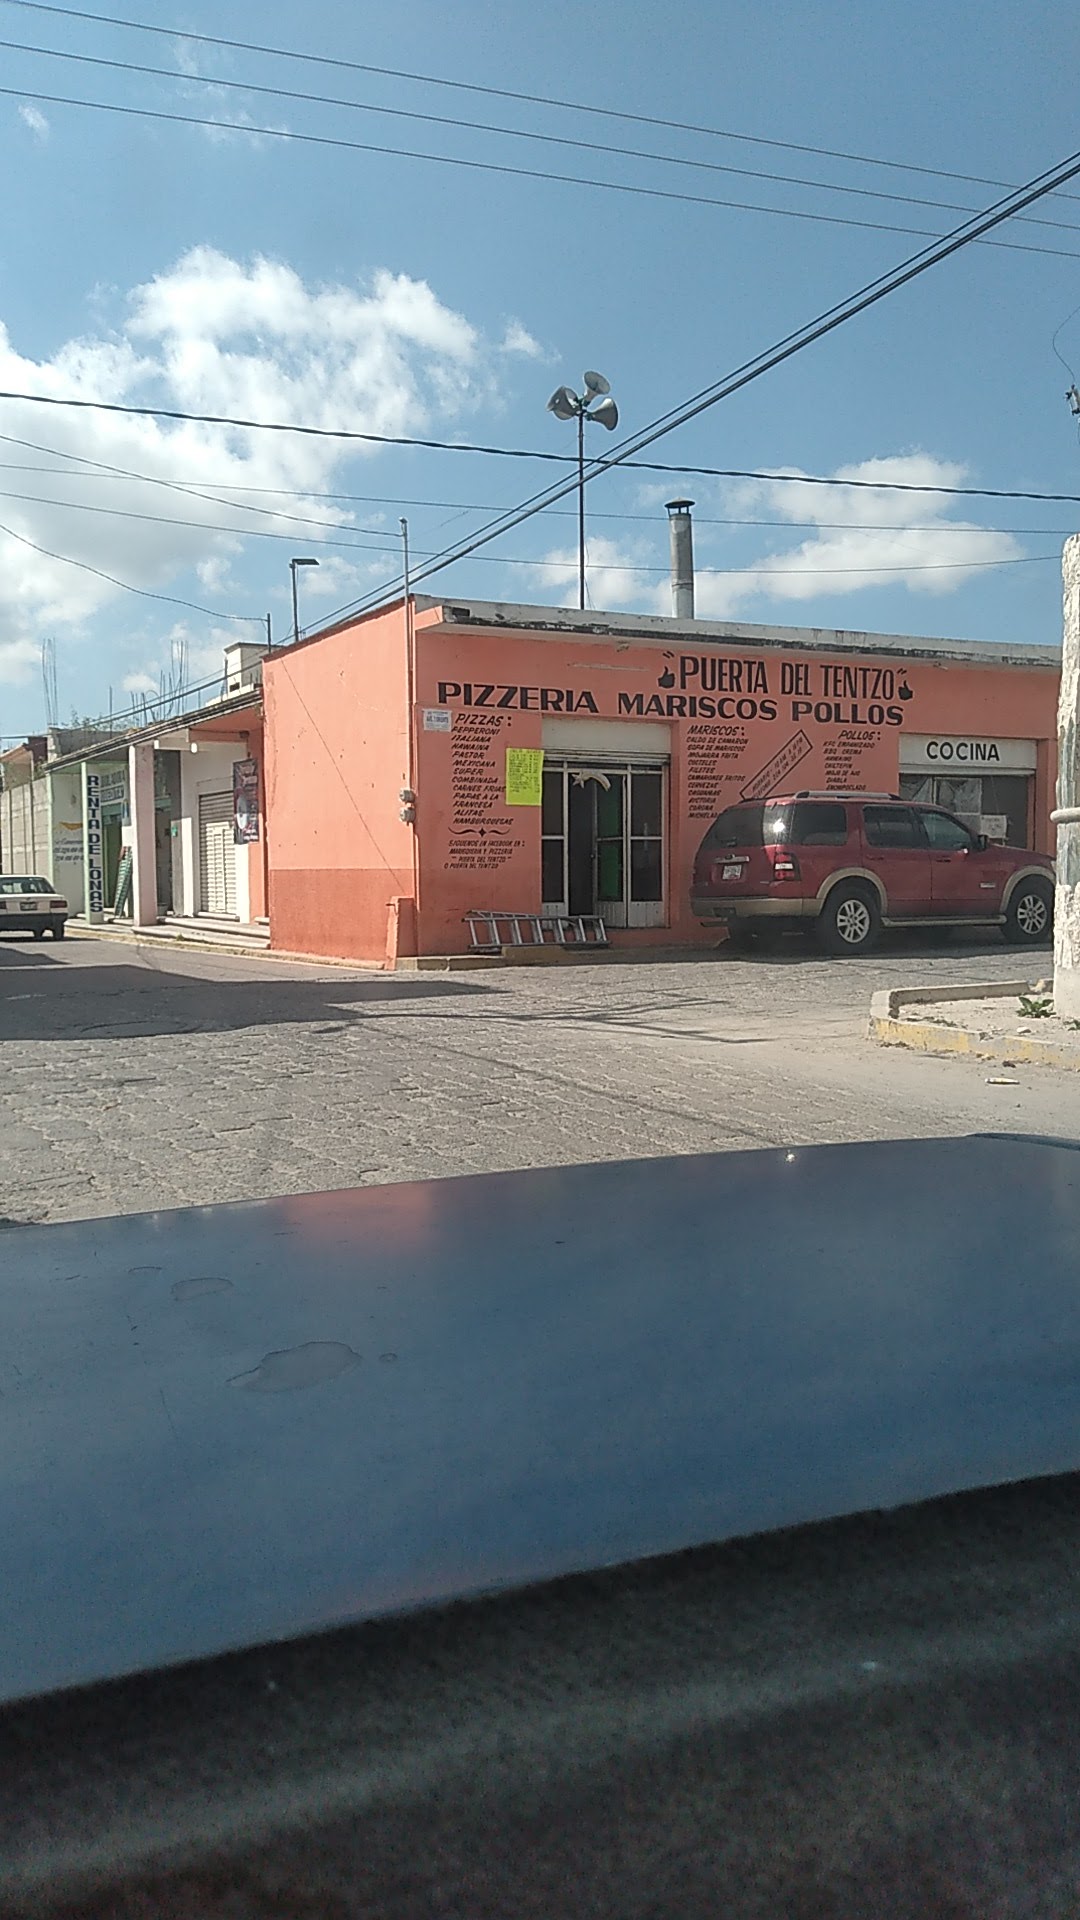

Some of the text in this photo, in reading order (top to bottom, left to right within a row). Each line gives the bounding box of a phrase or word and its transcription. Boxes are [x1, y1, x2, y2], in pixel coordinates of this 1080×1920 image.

[679, 655, 894, 700] PUERTA DEL TENTZO
[437, 681, 904, 726] PIZZERIA MARISCOS POLLOS
[451, 726, 501, 735] PEPPERONI
[452, 751, 485, 759] PASTOR
[926, 741, 1000, 762] COCINA
[453, 784, 482, 792] CARNES
[452, 817, 514, 825] HAMBURGUESAS
[87, 775, 103, 913] RENTA DE LONAS
